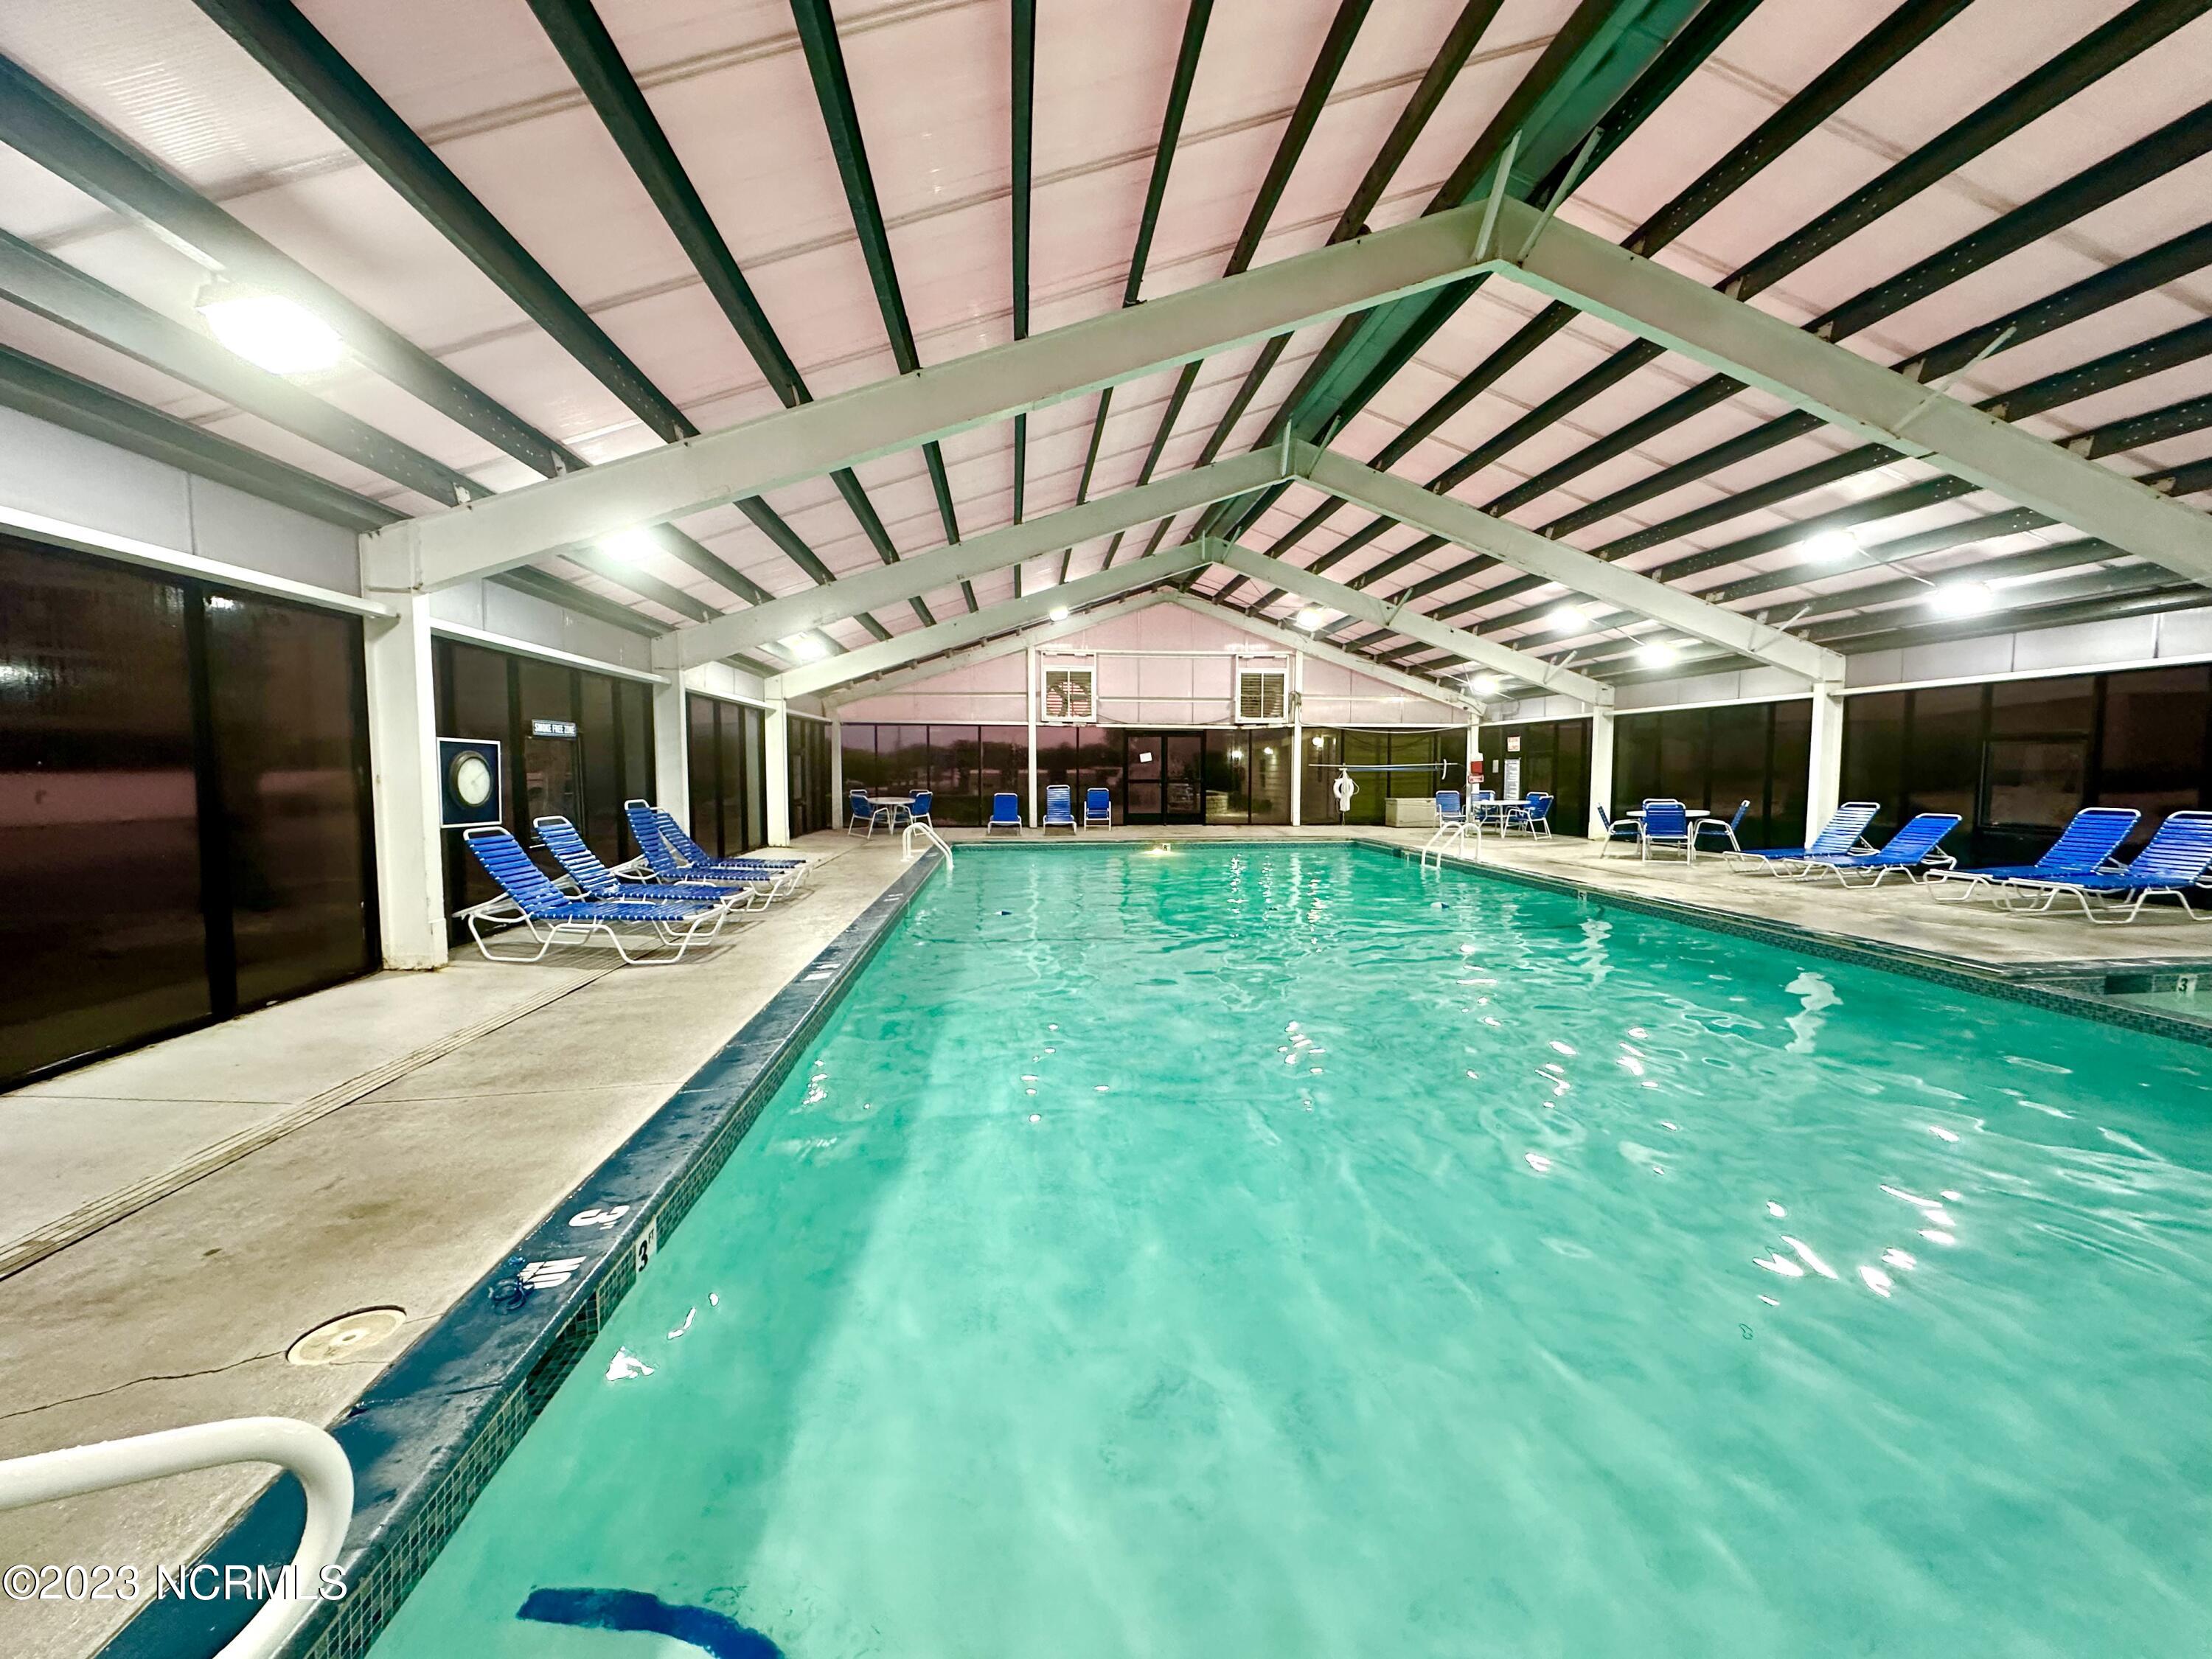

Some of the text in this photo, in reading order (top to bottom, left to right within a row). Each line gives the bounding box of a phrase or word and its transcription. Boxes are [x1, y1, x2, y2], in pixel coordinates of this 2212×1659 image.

[552, 724, 563, 733] FREE
[2179, 978, 2188, 992] 3
[639, 1228, 654, 1272] 3 FT
